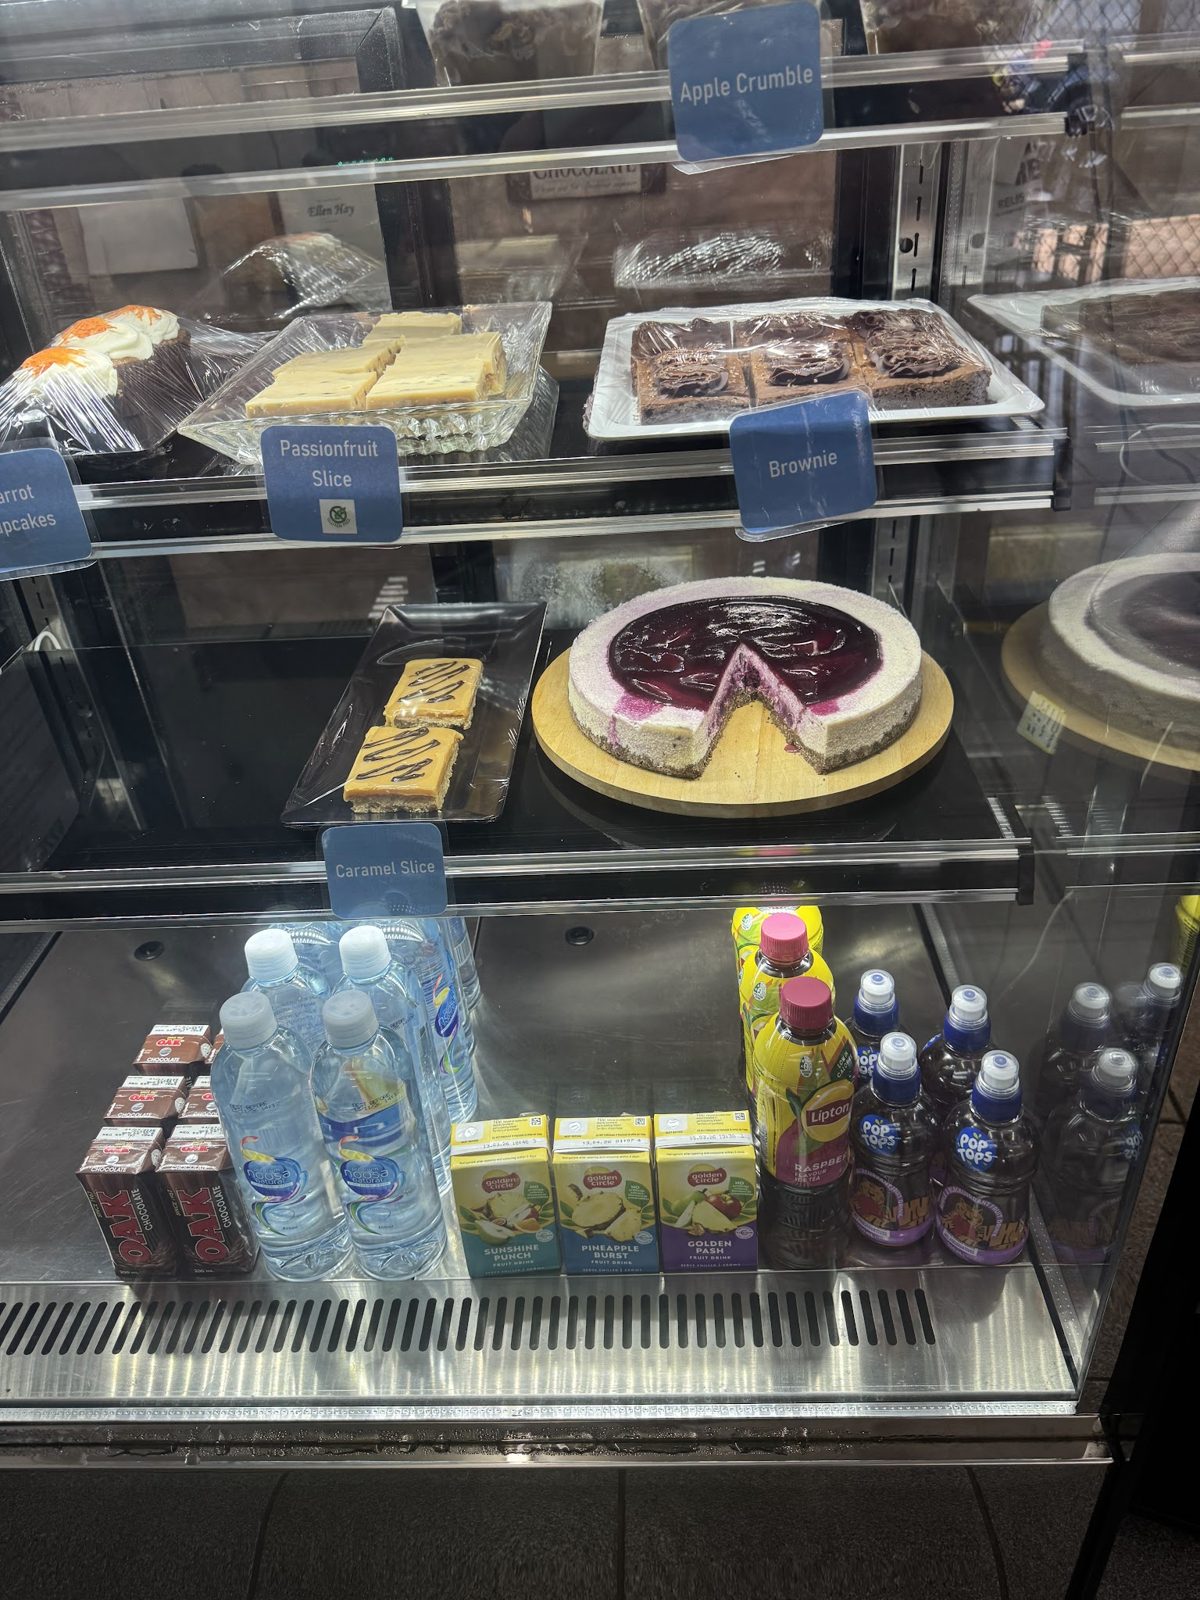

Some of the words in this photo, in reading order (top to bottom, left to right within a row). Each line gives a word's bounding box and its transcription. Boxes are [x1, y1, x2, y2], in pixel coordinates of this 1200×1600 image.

[680, 77, 731, 106] Apple
[736, 64, 813, 94] Crumble
[280, 439, 379, 457] Passionfruit
[768, 449, 838, 478] Brownie
[312, 470, 352, 488] Slice
[335, 861, 397, 878] Caramel
[400, 860, 435, 874] Slice
[811, 1102, 850, 1123] Lipton
[863, 1121, 890, 1138] POP
[861, 1134, 896, 1149] TOPS
[960, 1133, 989, 1152] POP
[957, 1148, 993, 1164] TOPS
[247, 1170, 291, 1180] noosa
[344, 1169, 389, 1179] noosa
[485, 1177, 517, 1187] golden
[587, 1174, 618, 1183] golden
[691, 1172, 722, 1180] golden
[490, 1182, 515, 1190] circle
[131, 1188, 153, 1231] CHOCOLATE
[212, 1185, 232, 1228] CHOCOLATE
[96, 1190, 153, 1264] OAK
[175, 1187, 230, 1263] OAK
[484, 1244, 540, 1255] SUNSHINE
[494, 1252, 532, 1261] PUNCH
